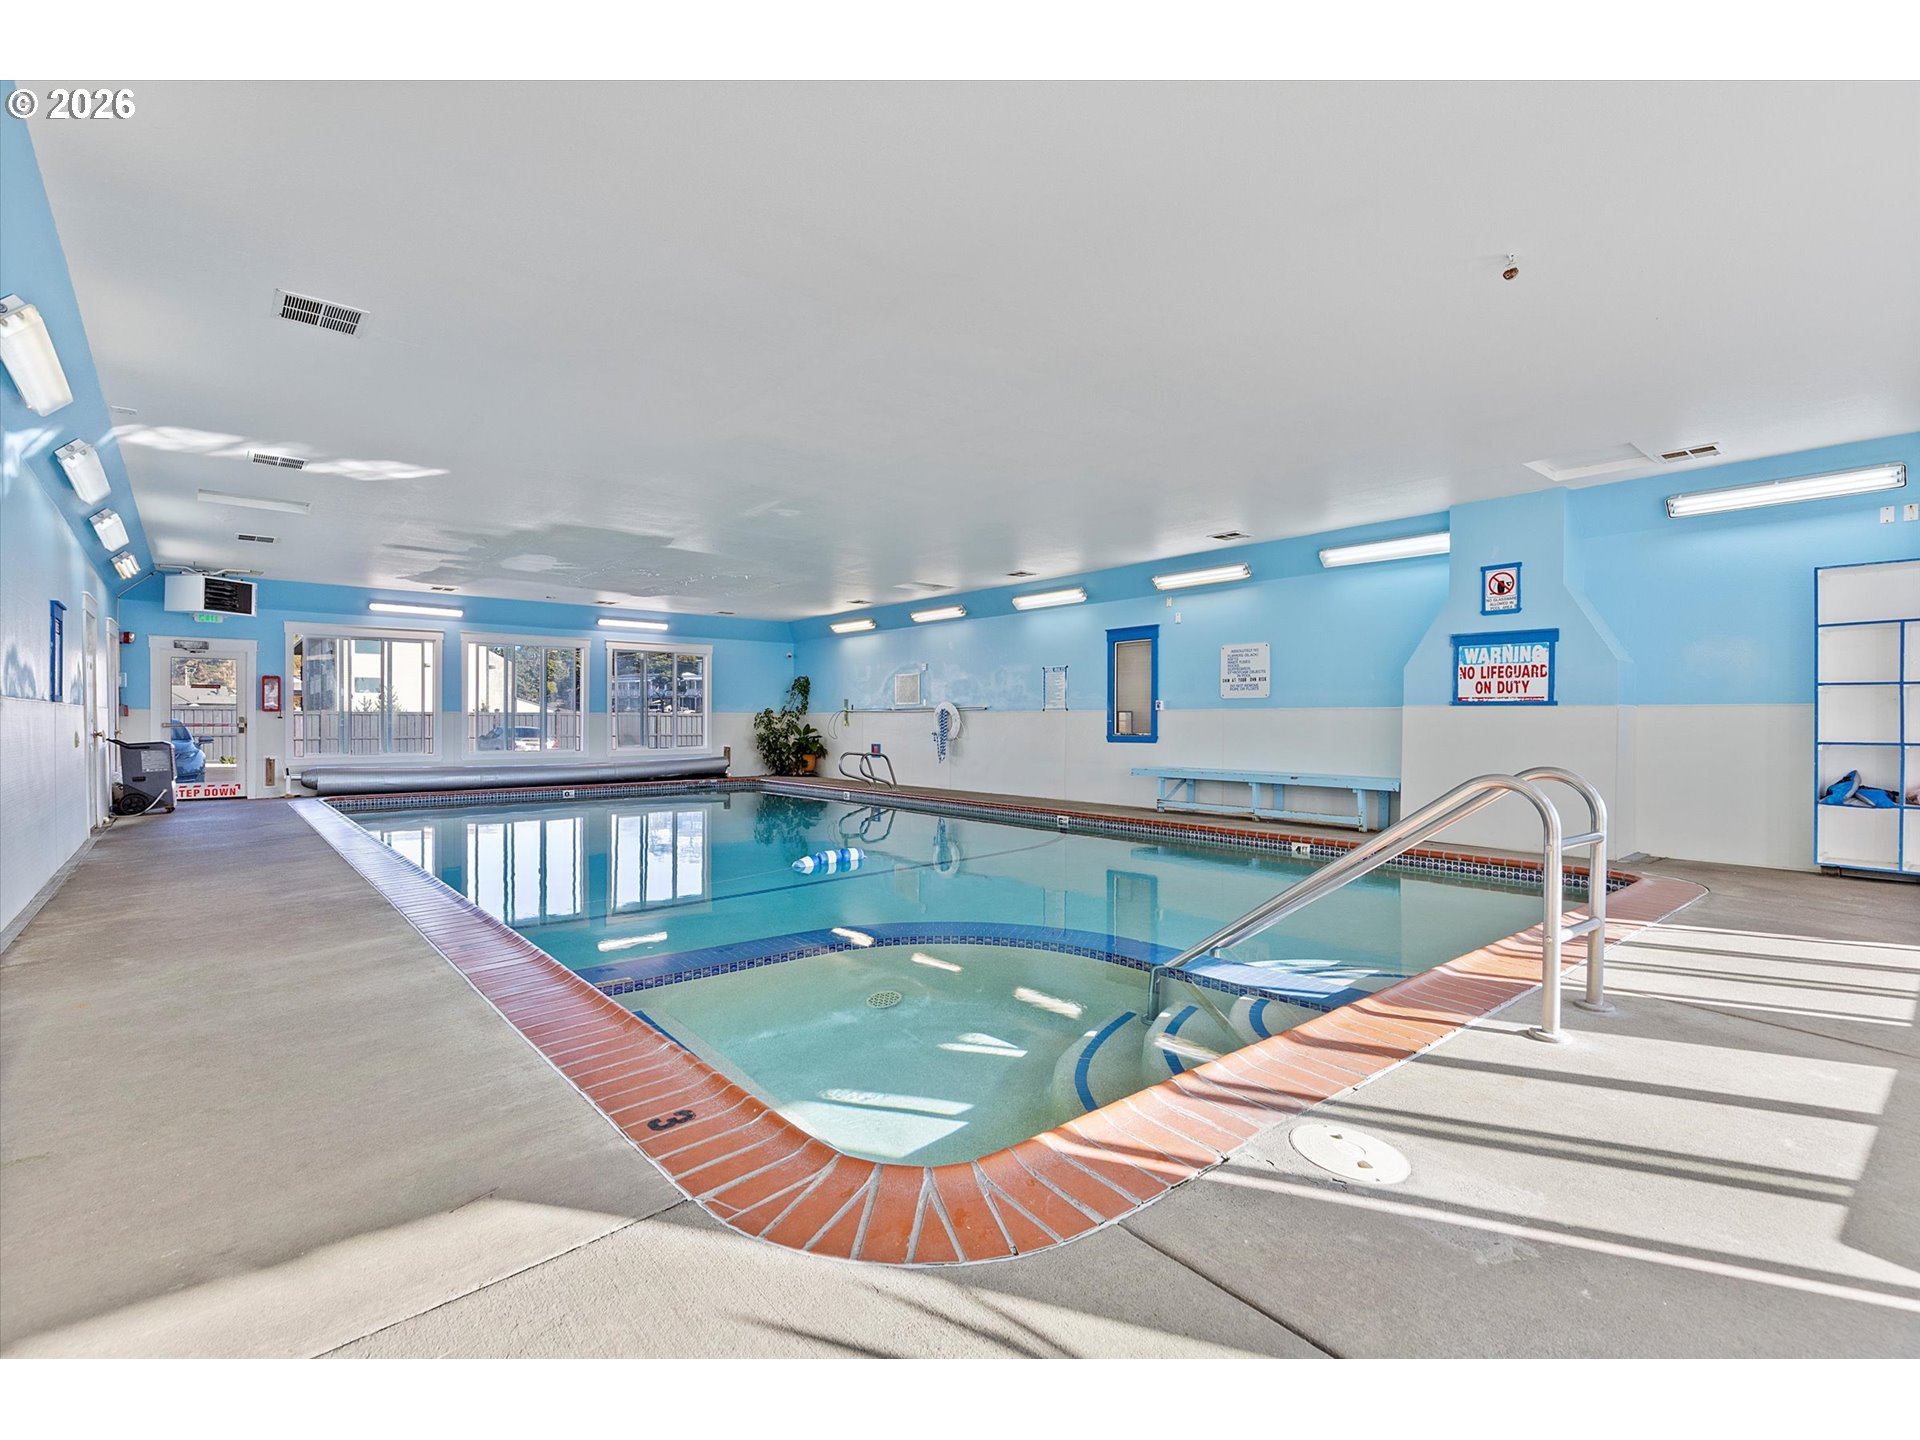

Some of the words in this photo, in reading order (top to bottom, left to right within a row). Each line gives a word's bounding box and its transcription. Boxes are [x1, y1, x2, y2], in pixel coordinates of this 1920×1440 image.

[1464, 644, 1546, 664] WARNING
[1460, 666, 1475, 679] NO
[1480, 664, 1548, 679] LIFEGUARD
[1475, 681, 1491, 694] ON
[1497, 680, 1530, 694] DUTY
[204, 788, 236, 796] DOWN
[647, 1110, 696, 1131] 3
